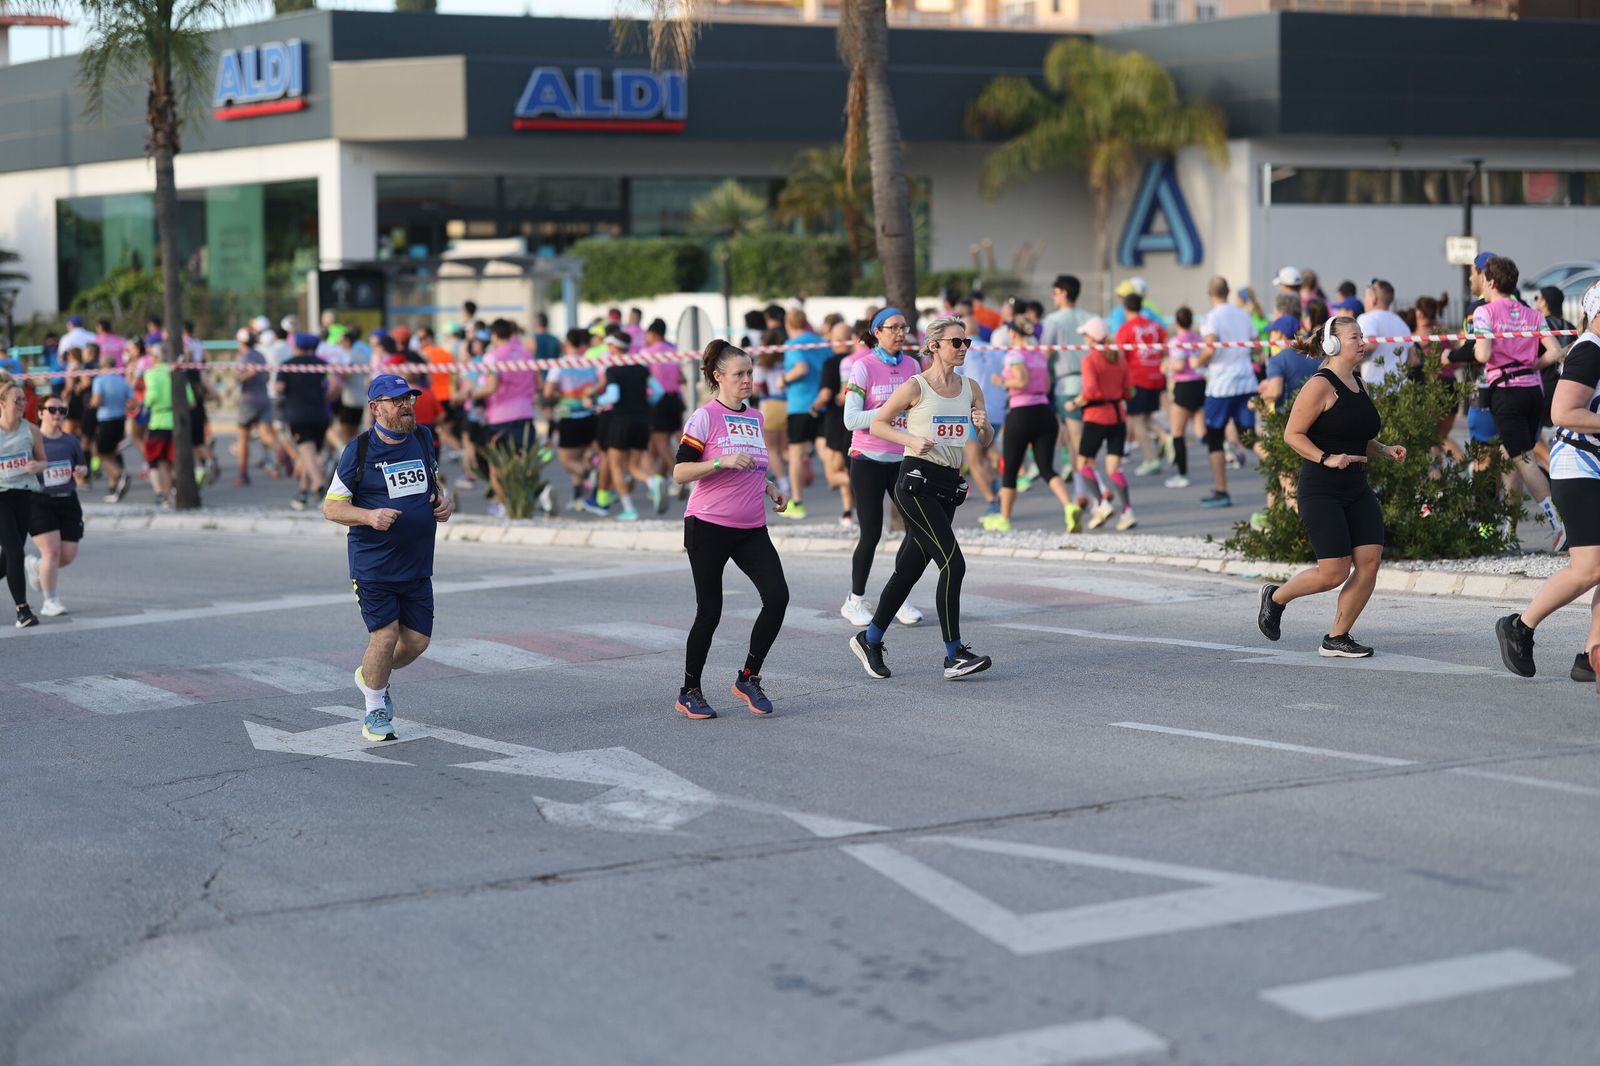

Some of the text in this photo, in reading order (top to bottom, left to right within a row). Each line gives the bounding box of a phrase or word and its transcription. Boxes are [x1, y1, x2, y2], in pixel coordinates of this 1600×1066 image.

[212, 38, 308, 107] ALDI
[514, 66, 688, 119] ALDI
[728, 422, 759, 437] 2157
[937, 424, 964, 437] 819
[388, 469, 425, 487] 1536
